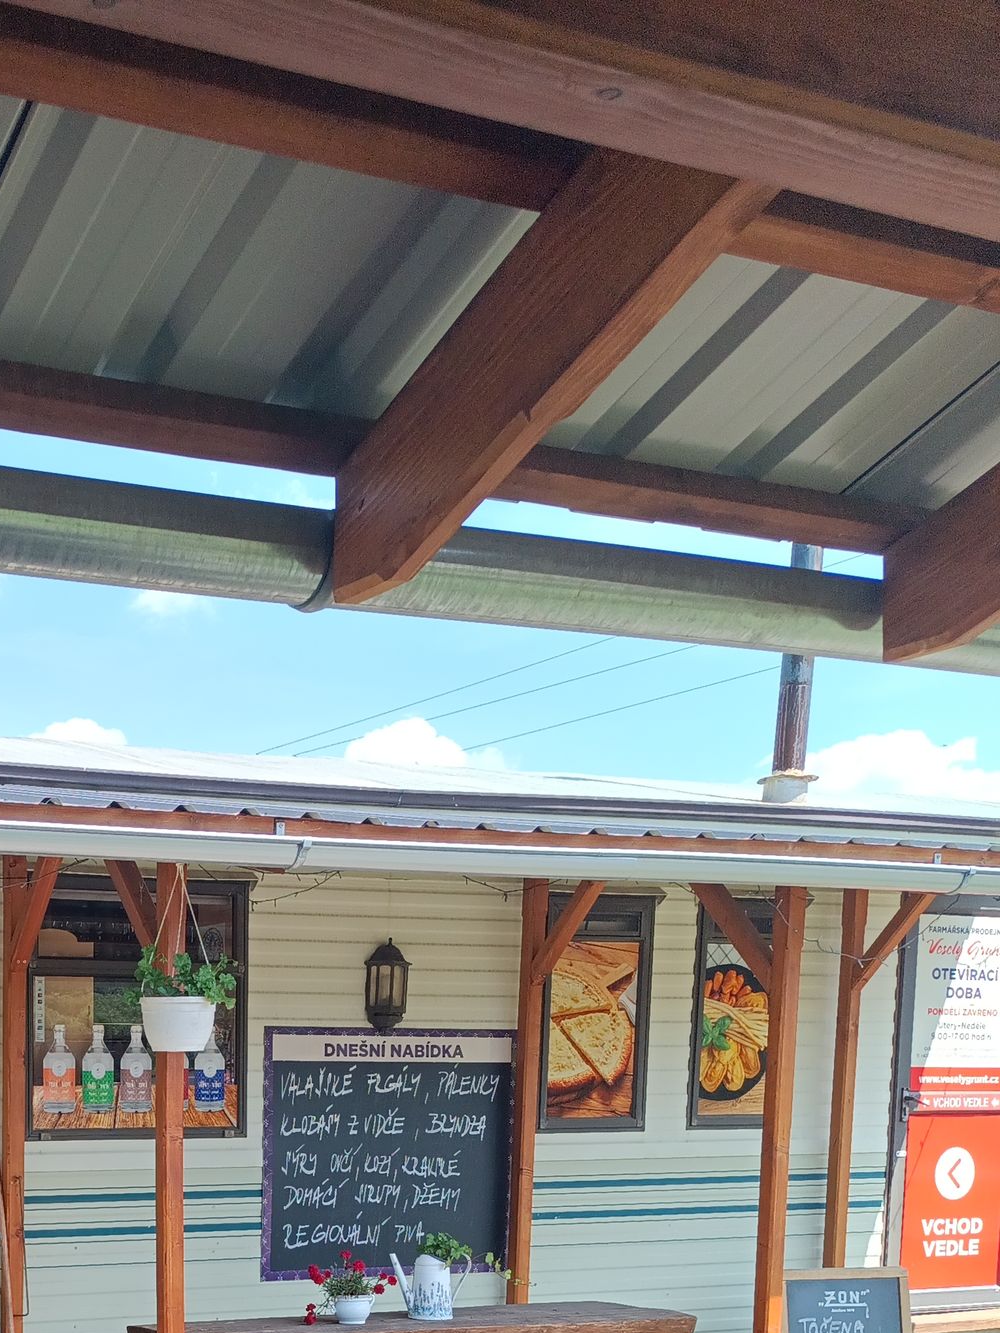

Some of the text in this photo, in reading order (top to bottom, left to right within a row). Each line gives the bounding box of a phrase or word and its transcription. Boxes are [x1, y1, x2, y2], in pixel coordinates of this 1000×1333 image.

[967, 940, 1000, 960] Grun
[931, 966, 999, 981] OTEVÍRACÍ
[945, 986, 982, 999] DOBA
[323, 1040, 464, 1059] DNEŠNÍ NABÍDKA
[933, 1097, 989, 1108] VCHOD VEDLE
[347, 1115, 358, 1135] Z
[281, 1144, 317, 1178] SÝRY
[283, 1178, 350, 1210] DOMÁCÍ
[282, 1211, 425, 1249] REGIONÁLNÍ PIVA
[921, 1217, 984, 1236] VCHOD
[922, 1238, 980, 1257] VEDLE
